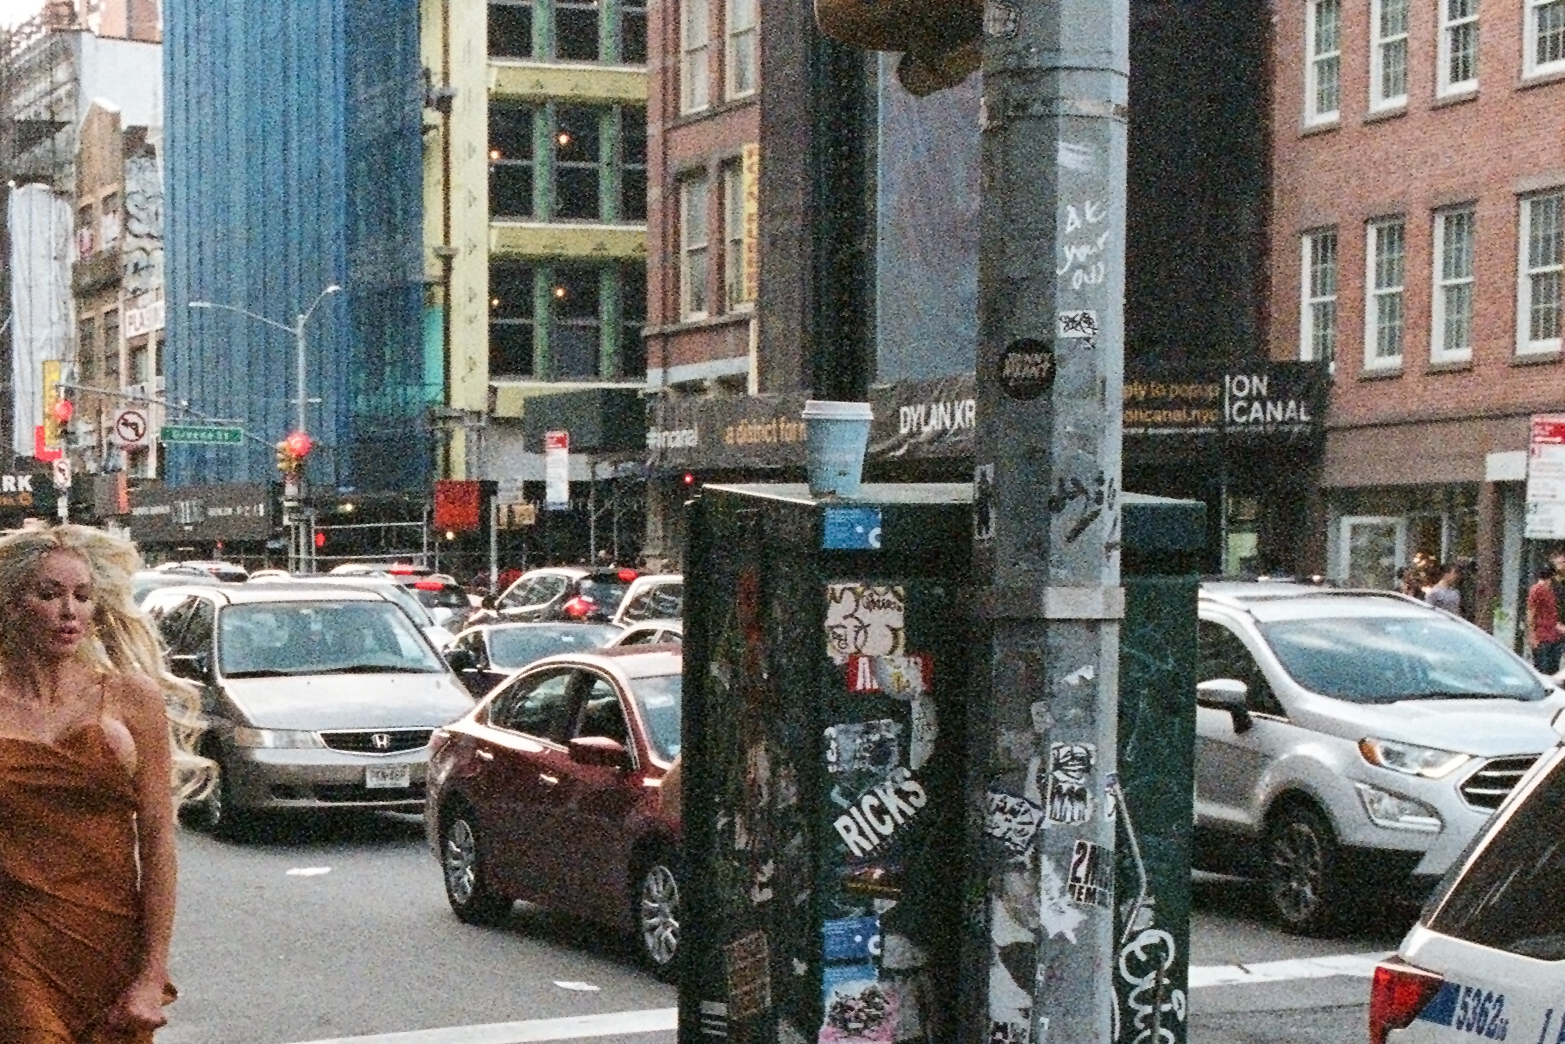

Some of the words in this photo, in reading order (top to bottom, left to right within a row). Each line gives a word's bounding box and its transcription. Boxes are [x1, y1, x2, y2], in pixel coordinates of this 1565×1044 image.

[1232, 374, 1268, 397] ON
[899, 401, 952, 434] DYLAN
[953, 399, 977, 430] KR
[1232, 400, 1312, 423] CANAL
[833, 766, 928, 858] RICKS
